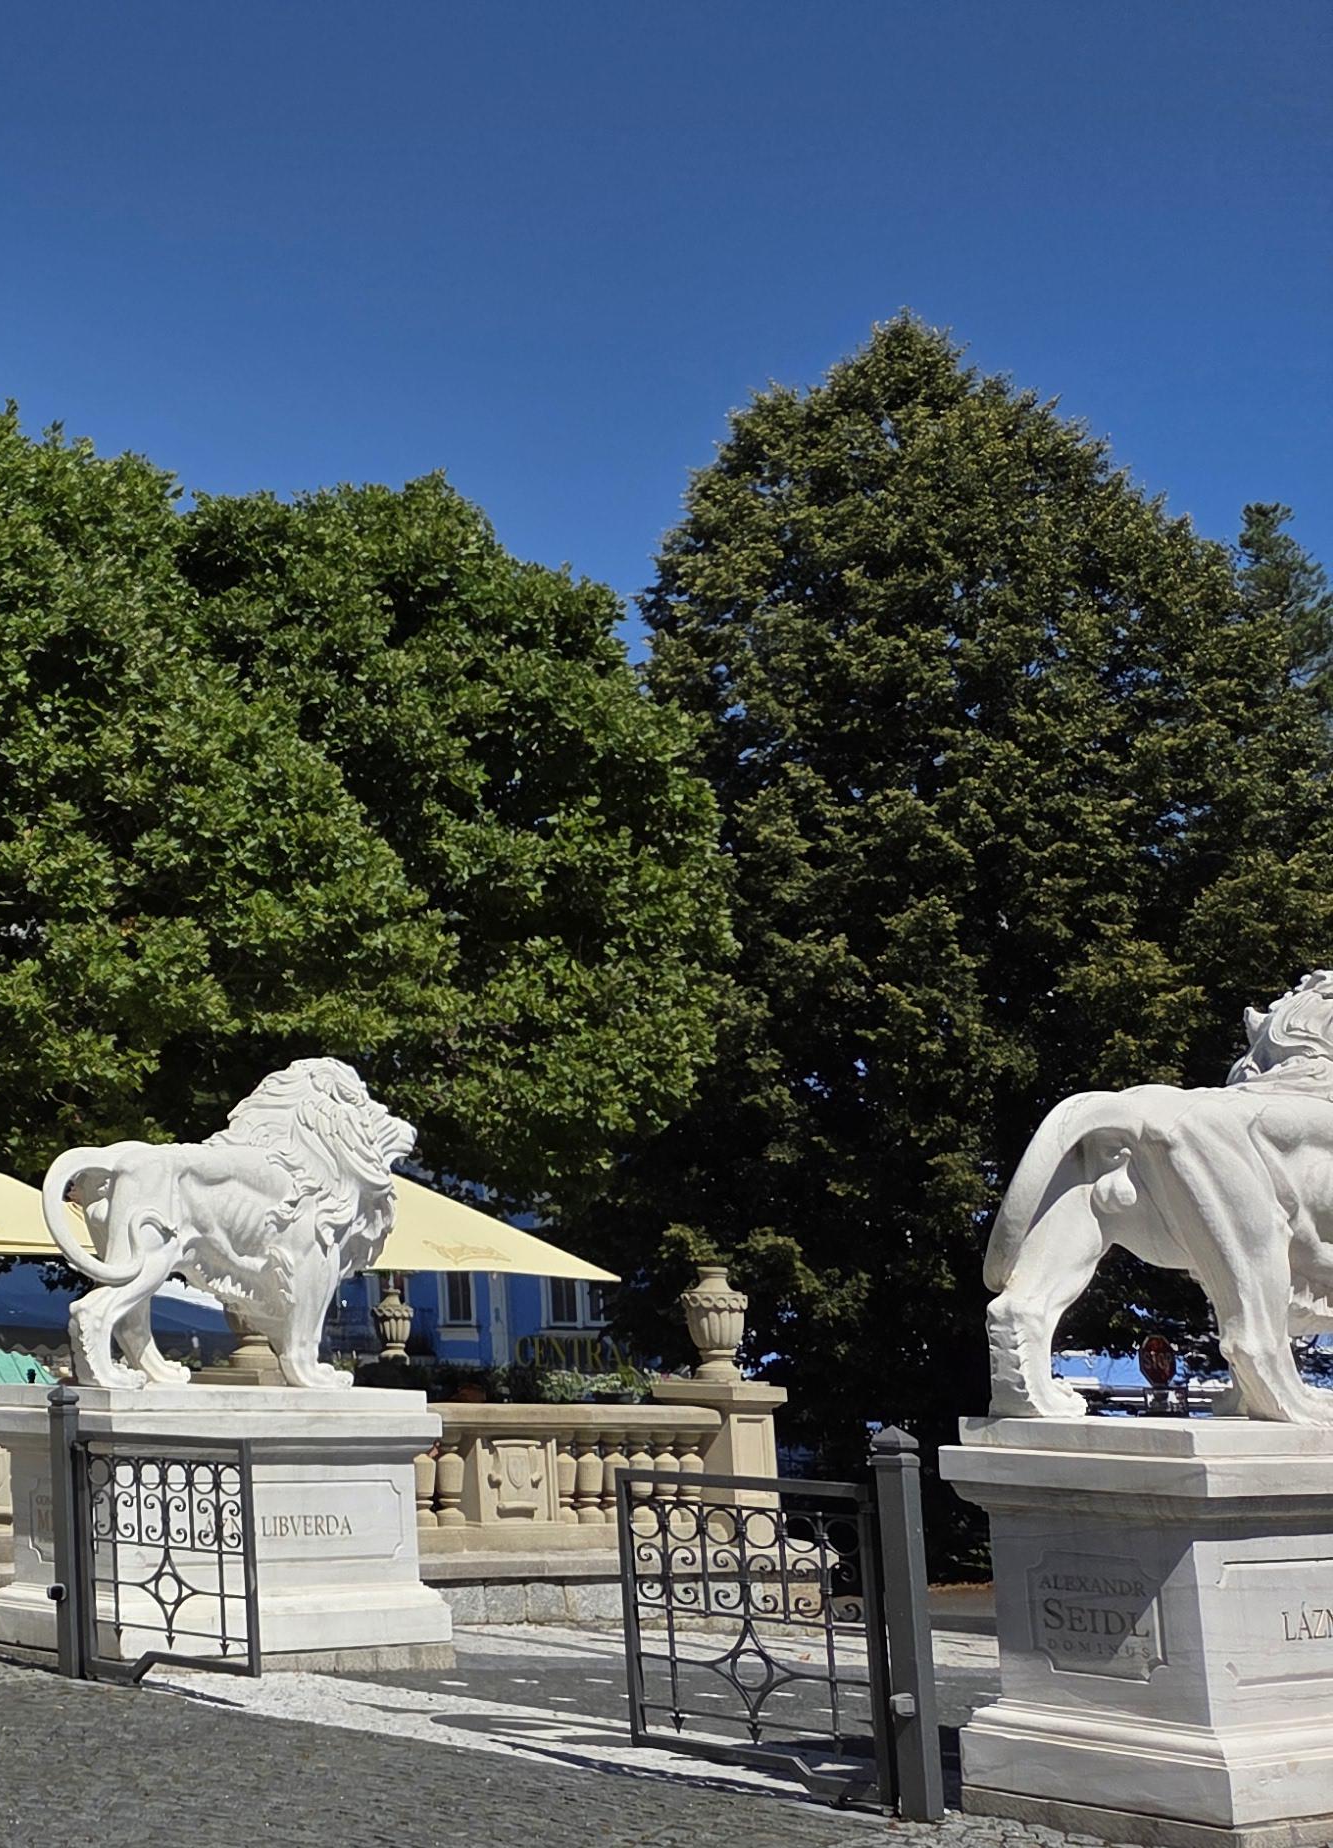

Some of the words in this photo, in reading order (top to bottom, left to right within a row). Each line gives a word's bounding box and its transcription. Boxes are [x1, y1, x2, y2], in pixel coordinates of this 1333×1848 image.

[260, 1514, 353, 1538] LIBVERDA
[1039, 1573, 1146, 1598] ALEXANDR
[1042, 1597, 1150, 1638] SEIDL
[1046, 1638, 1152, 1659] DOMINUS
